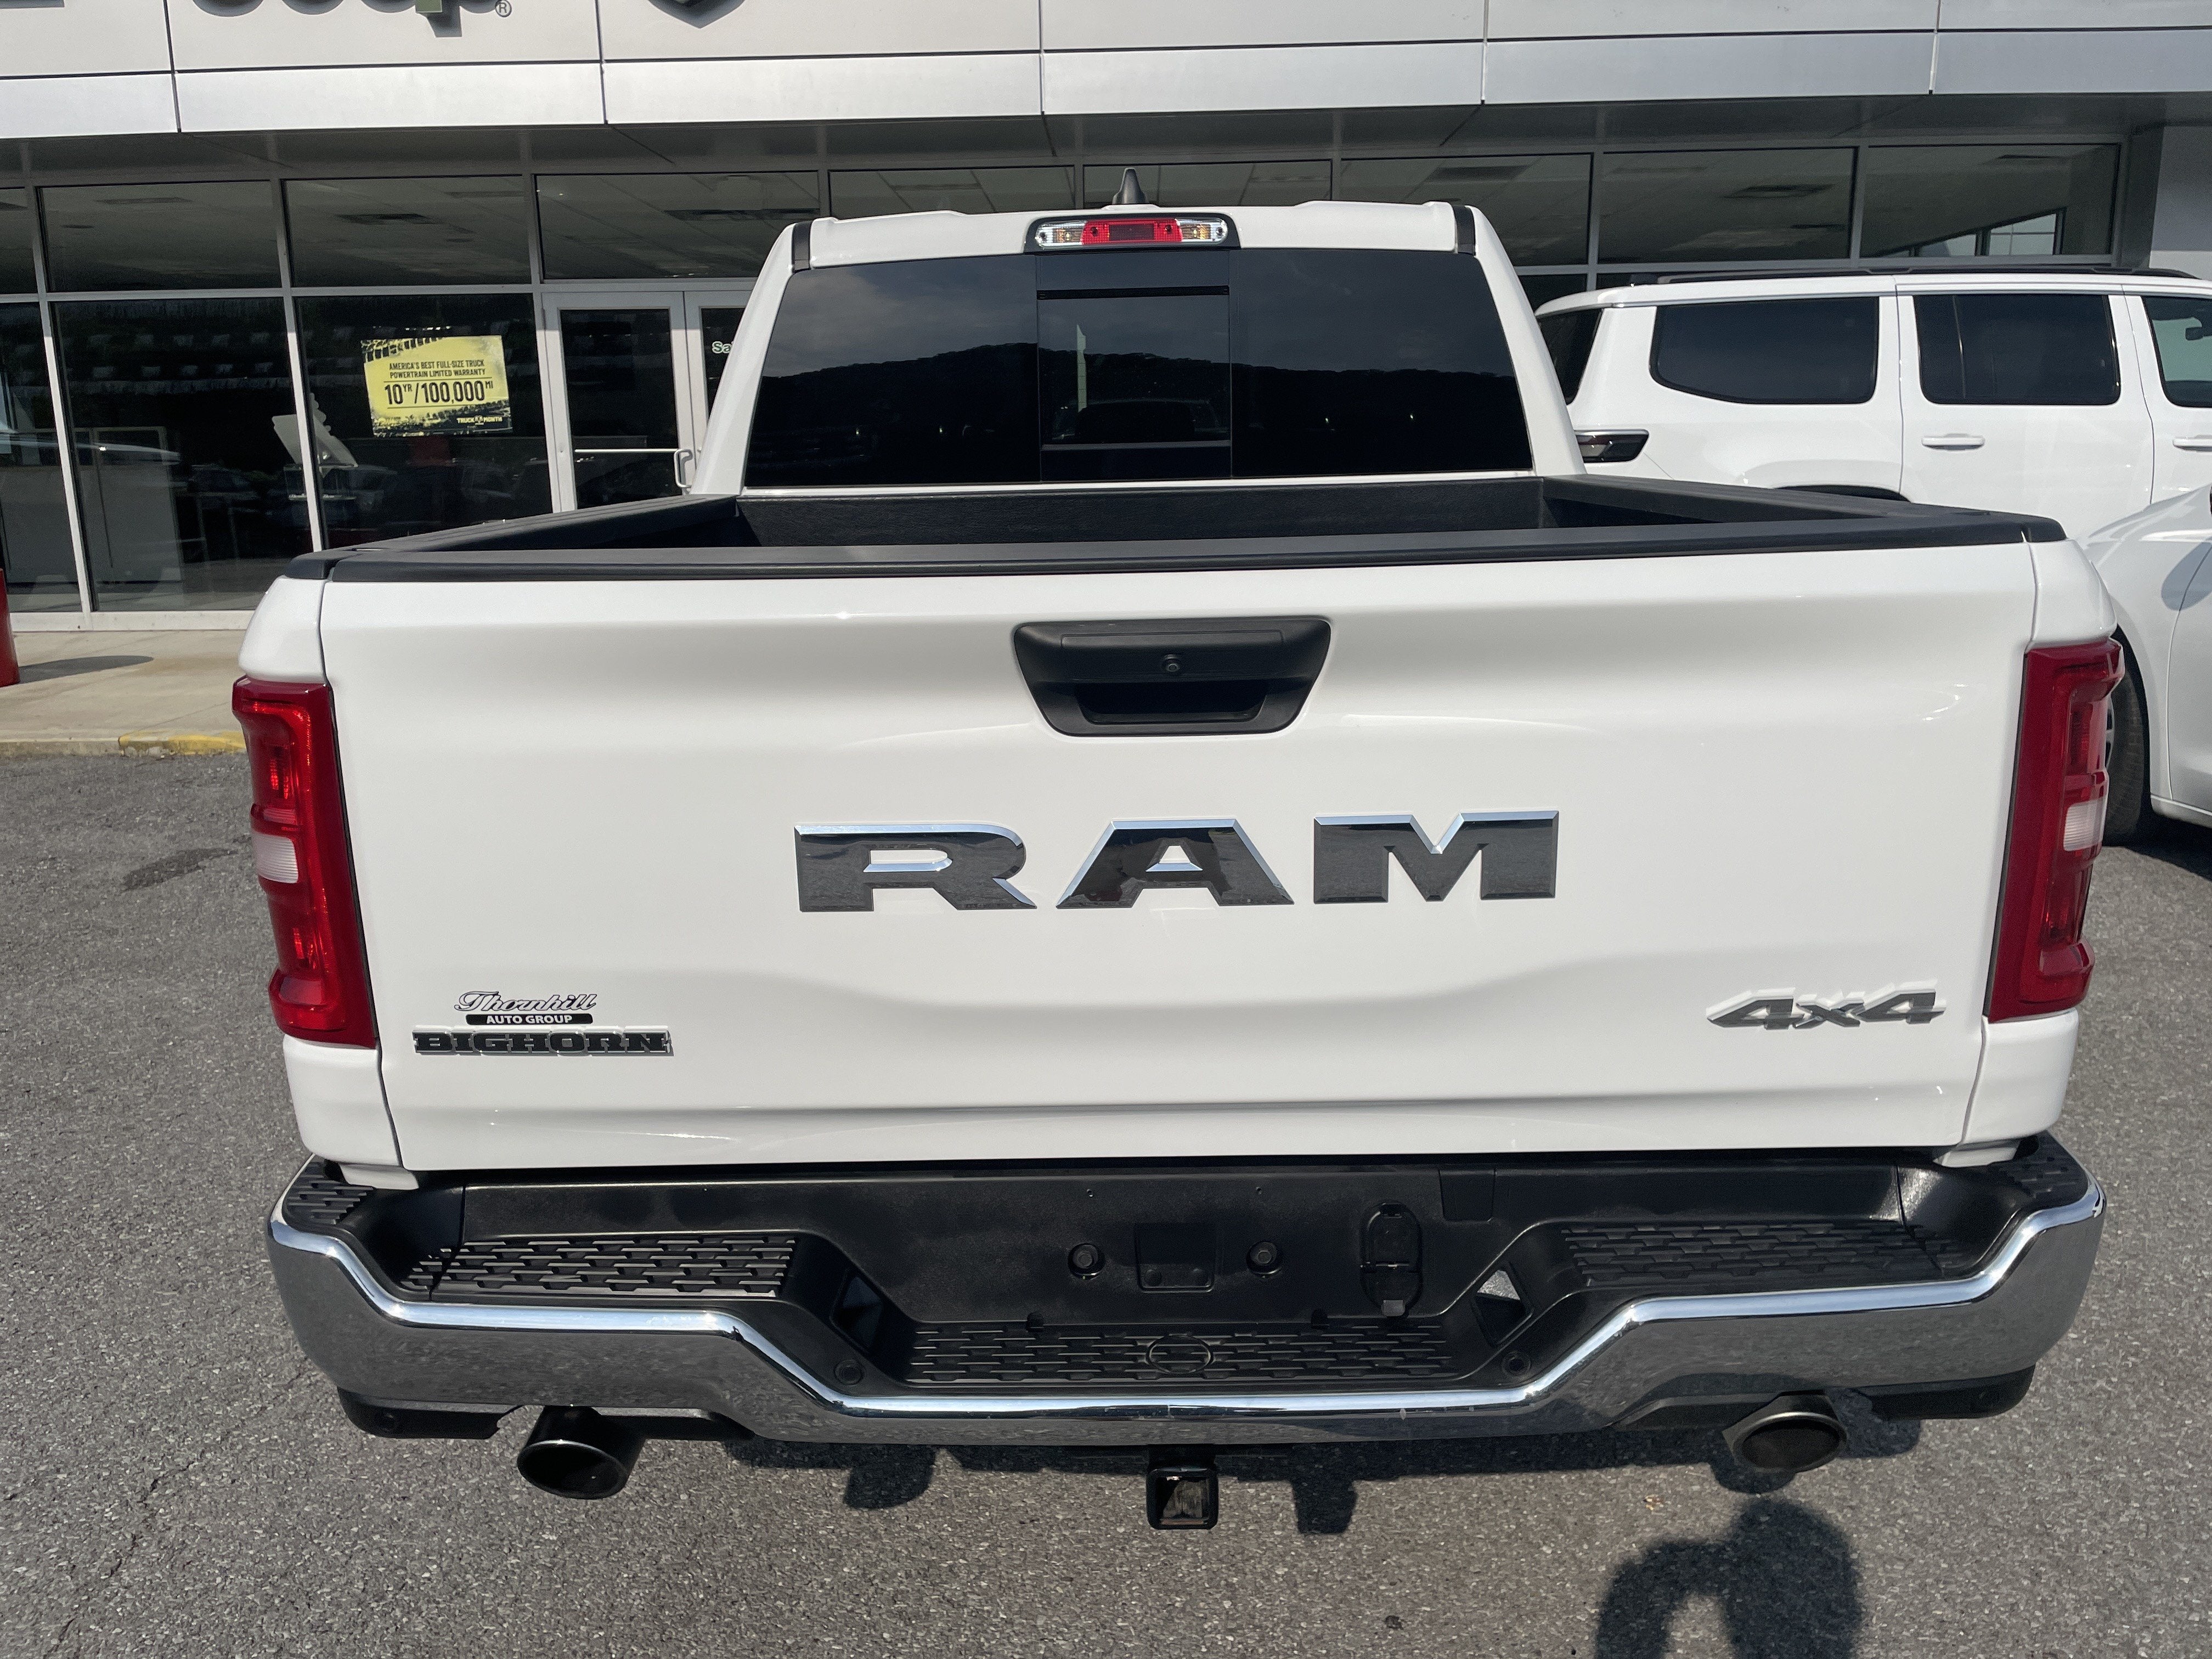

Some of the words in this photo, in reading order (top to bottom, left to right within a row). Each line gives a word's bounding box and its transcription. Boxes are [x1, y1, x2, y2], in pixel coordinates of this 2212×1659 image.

[712, 341, 734, 354] Sa
[389, 362, 420, 370] AMERICA'S
[421, 361, 435, 369] BEST
[436, 360, 465, 368] FULL-SIZE
[390, 370, 428, 379] POWERTRAIN
[794, 810, 1559, 912] RAM
[454, 990, 597, 1012] Thornhill
[486, 1015, 523, 1024] AUTO
[525, 1014, 573, 1024] GROUP
[413, 1028, 672, 1054] BIGHORN
